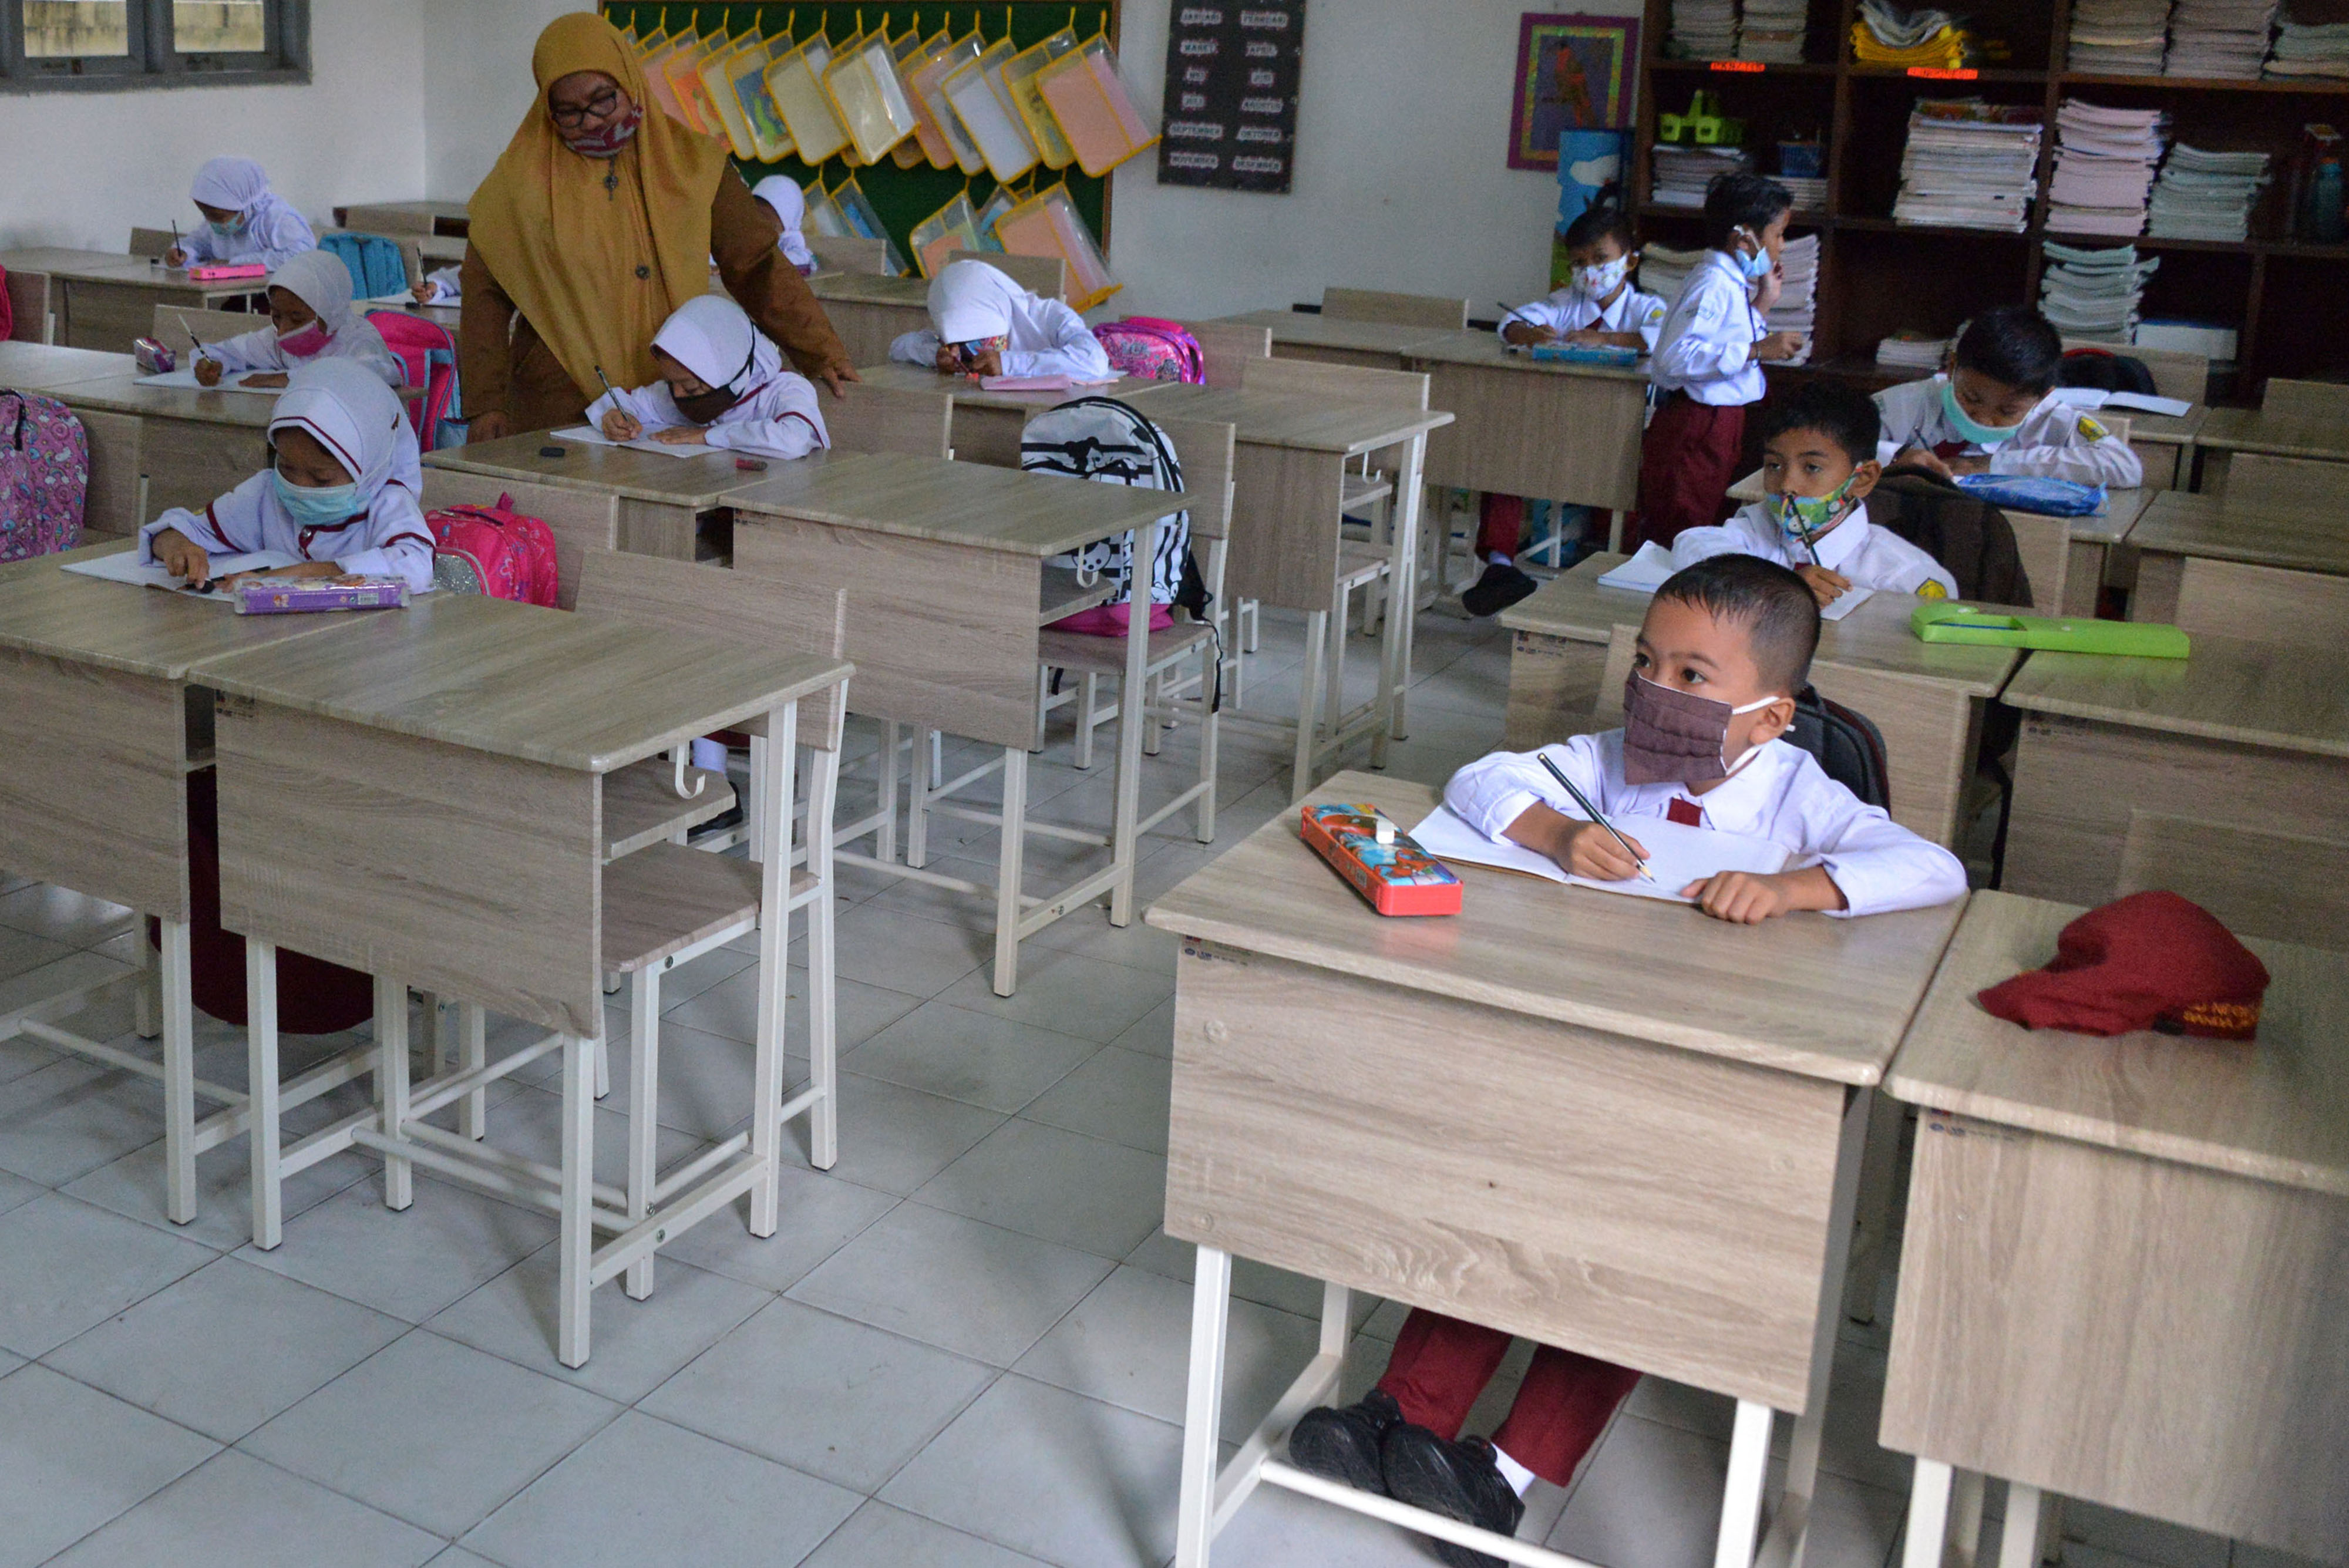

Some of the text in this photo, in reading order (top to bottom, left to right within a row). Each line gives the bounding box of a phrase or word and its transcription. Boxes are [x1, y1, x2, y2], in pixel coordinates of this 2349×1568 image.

[1171, 125, 1220, 136] SEPTEMBER
[1172, 154, 1216, 165] NOVEMBER
[1236, 159, 1280, 170] DESEMBER
